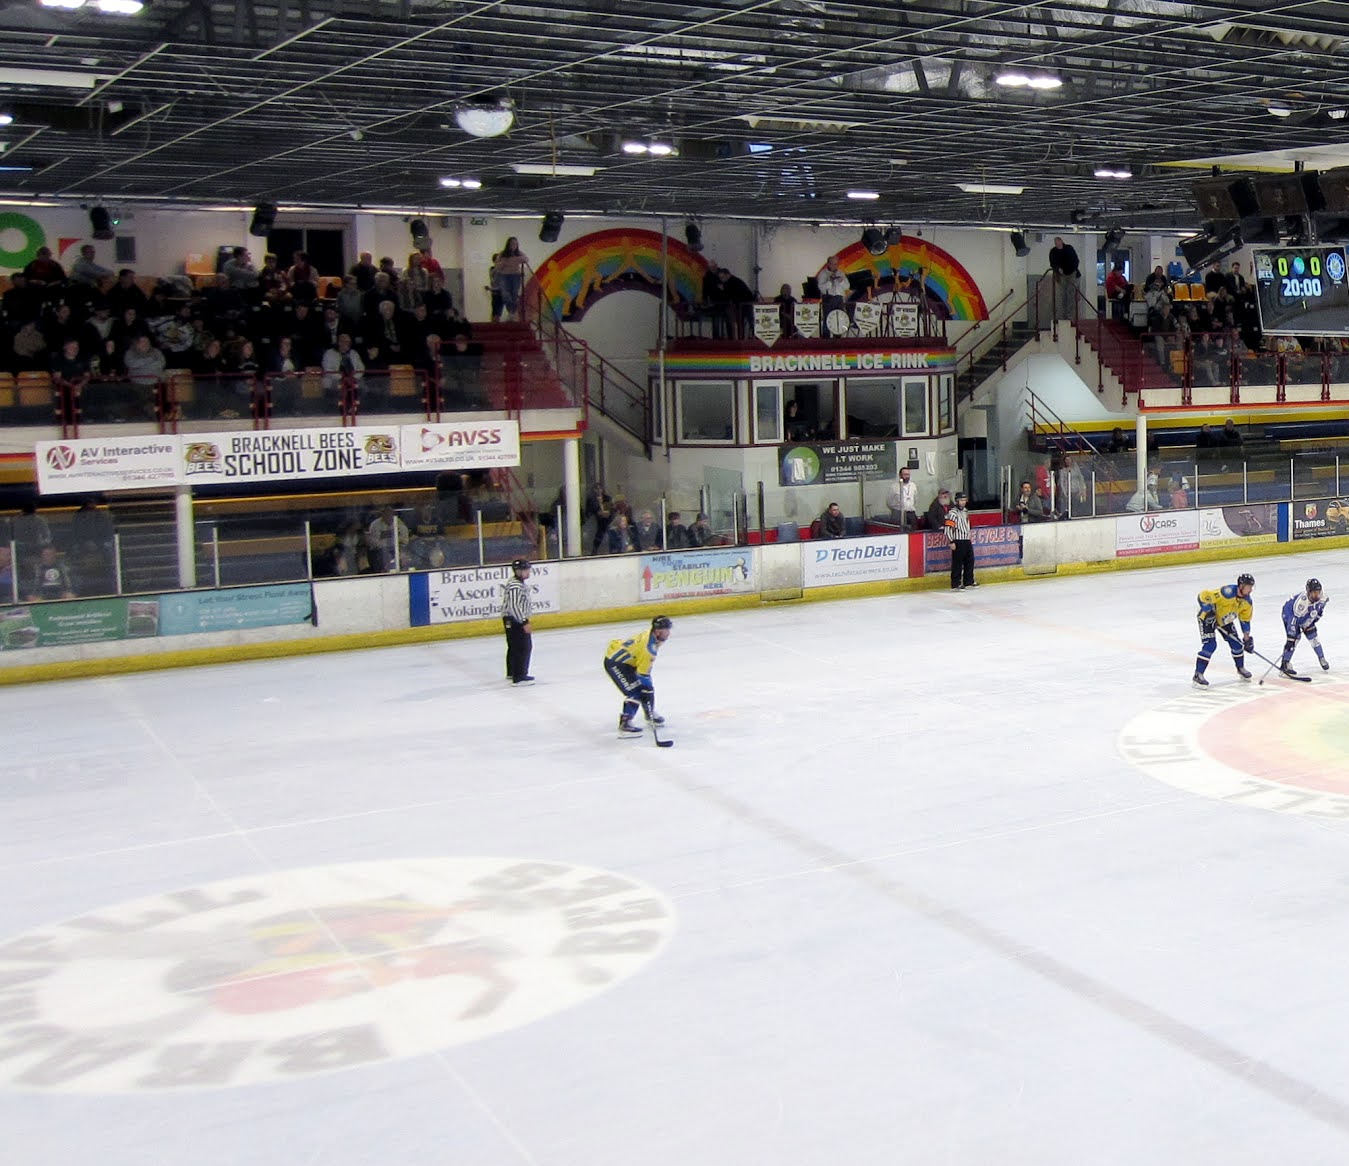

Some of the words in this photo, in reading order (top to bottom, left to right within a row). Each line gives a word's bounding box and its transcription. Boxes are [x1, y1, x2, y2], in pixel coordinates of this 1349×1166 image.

[1278, 257, 1288, 276] 0
[1310, 256, 1320, 276] 0
[1282, 278, 1322, 297] 20:00
[750, 354, 850, 372] BRACKNELL
[857, 353, 884, 370] ICE
[891, 352, 929, 369] RINK
[232, 434, 315, 454] BRACKNELL
[319, 432, 355, 449] BEES
[448, 428, 502, 447] AVSS
[80, 447, 100, 458] AV
[103, 444, 173, 457] Interactive
[822, 446, 836, 454] WE
[838, 445, 860, 454] JUST
[861, 444, 886, 452] MAKE
[80, 458, 119, 466] Services
[224, 450, 306, 477] SCHOOL
[313, 448, 363, 472] ZONE
[366, 452, 398, 465] BEES
[848, 454, 874, 462] WORK
[184, 461, 223, 475] BEES
[1154, 519, 1178, 529] CARS
[1294, 519, 1326, 529] Thames
[978, 527, 1006, 544] CYCLE
[830, 546, 863, 561] Tech
[864, 543, 896, 559] Data
[672, 562, 711, 571] STABILITY
[441, 567, 509, 585] Bracknell
[531, 566, 549, 577] ws
[652, 567, 733, 589] PENGUIN
[452, 586, 496, 602] Ascot
[703, 582, 724, 590] HERE
[441, 601, 505, 618] Wokingha
[531, 599, 551, 611] ews
